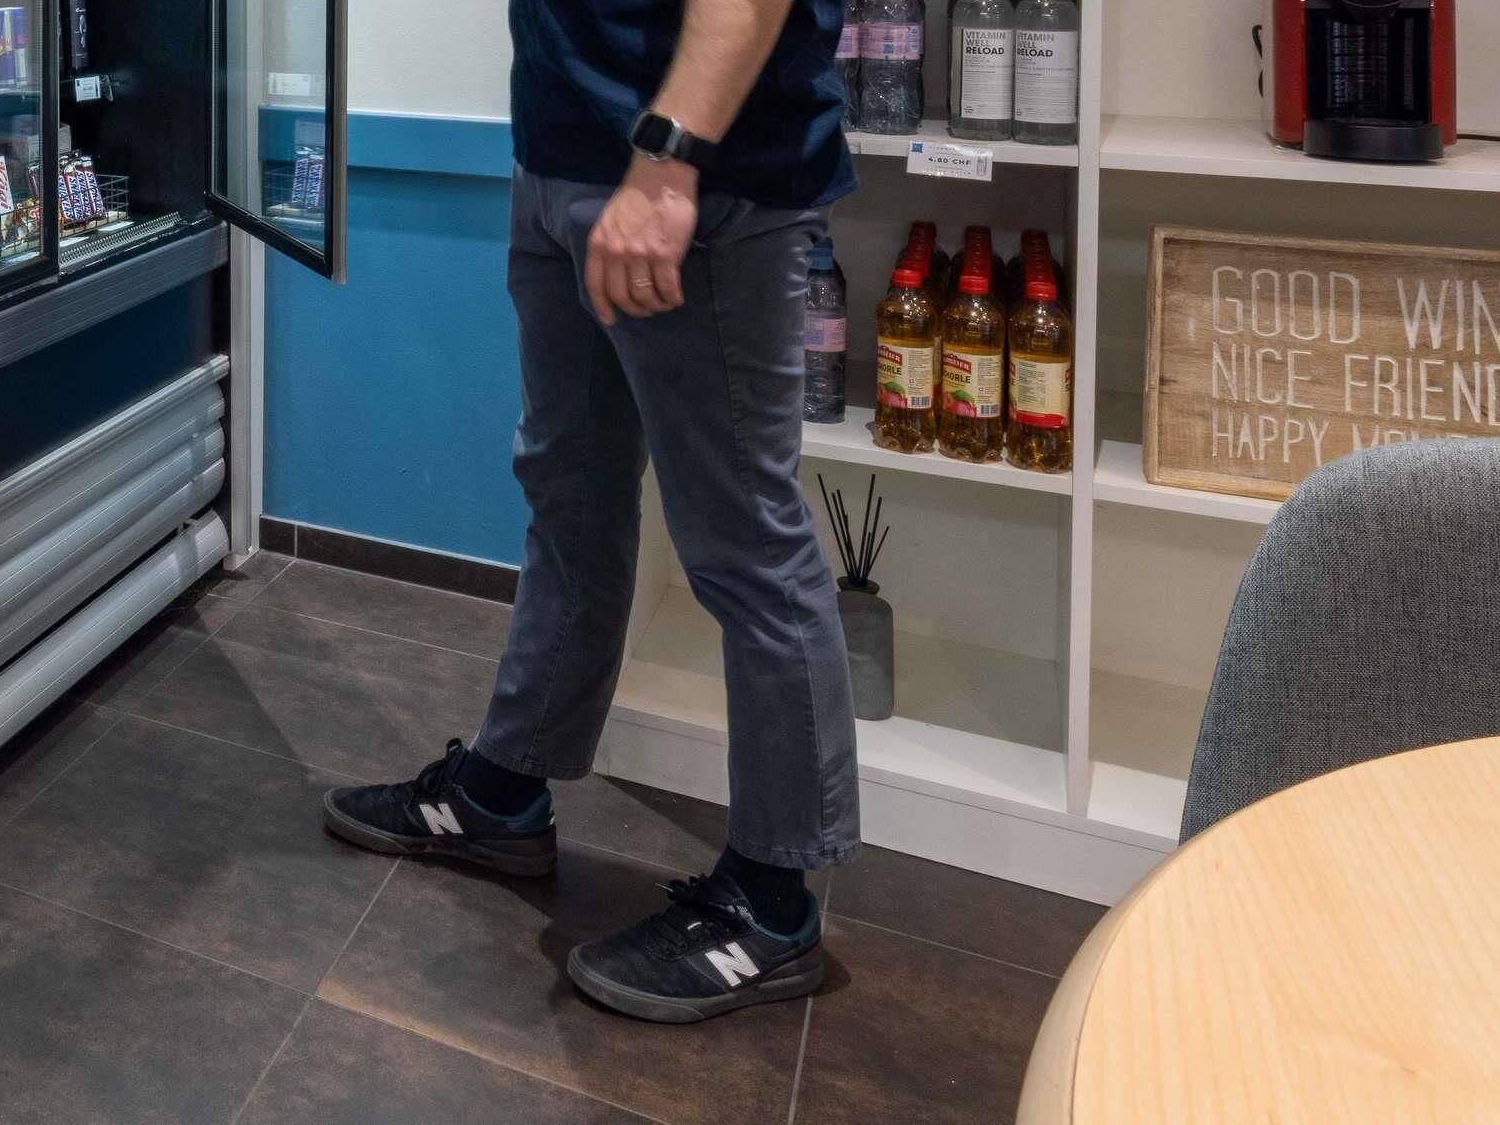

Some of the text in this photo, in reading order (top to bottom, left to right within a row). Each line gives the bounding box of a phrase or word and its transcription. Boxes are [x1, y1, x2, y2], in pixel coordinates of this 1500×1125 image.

[965, 32, 1005, 40] VITAMIN
[965, 39, 988, 47] WELL
[1212, 266, 1500, 355] GOOD WIN
[1212, 341, 1315, 409] NICE
[1212, 407, 1329, 467] HAPPY
[419, 802, 463, 834] N
[705, 941, 760, 986] N
